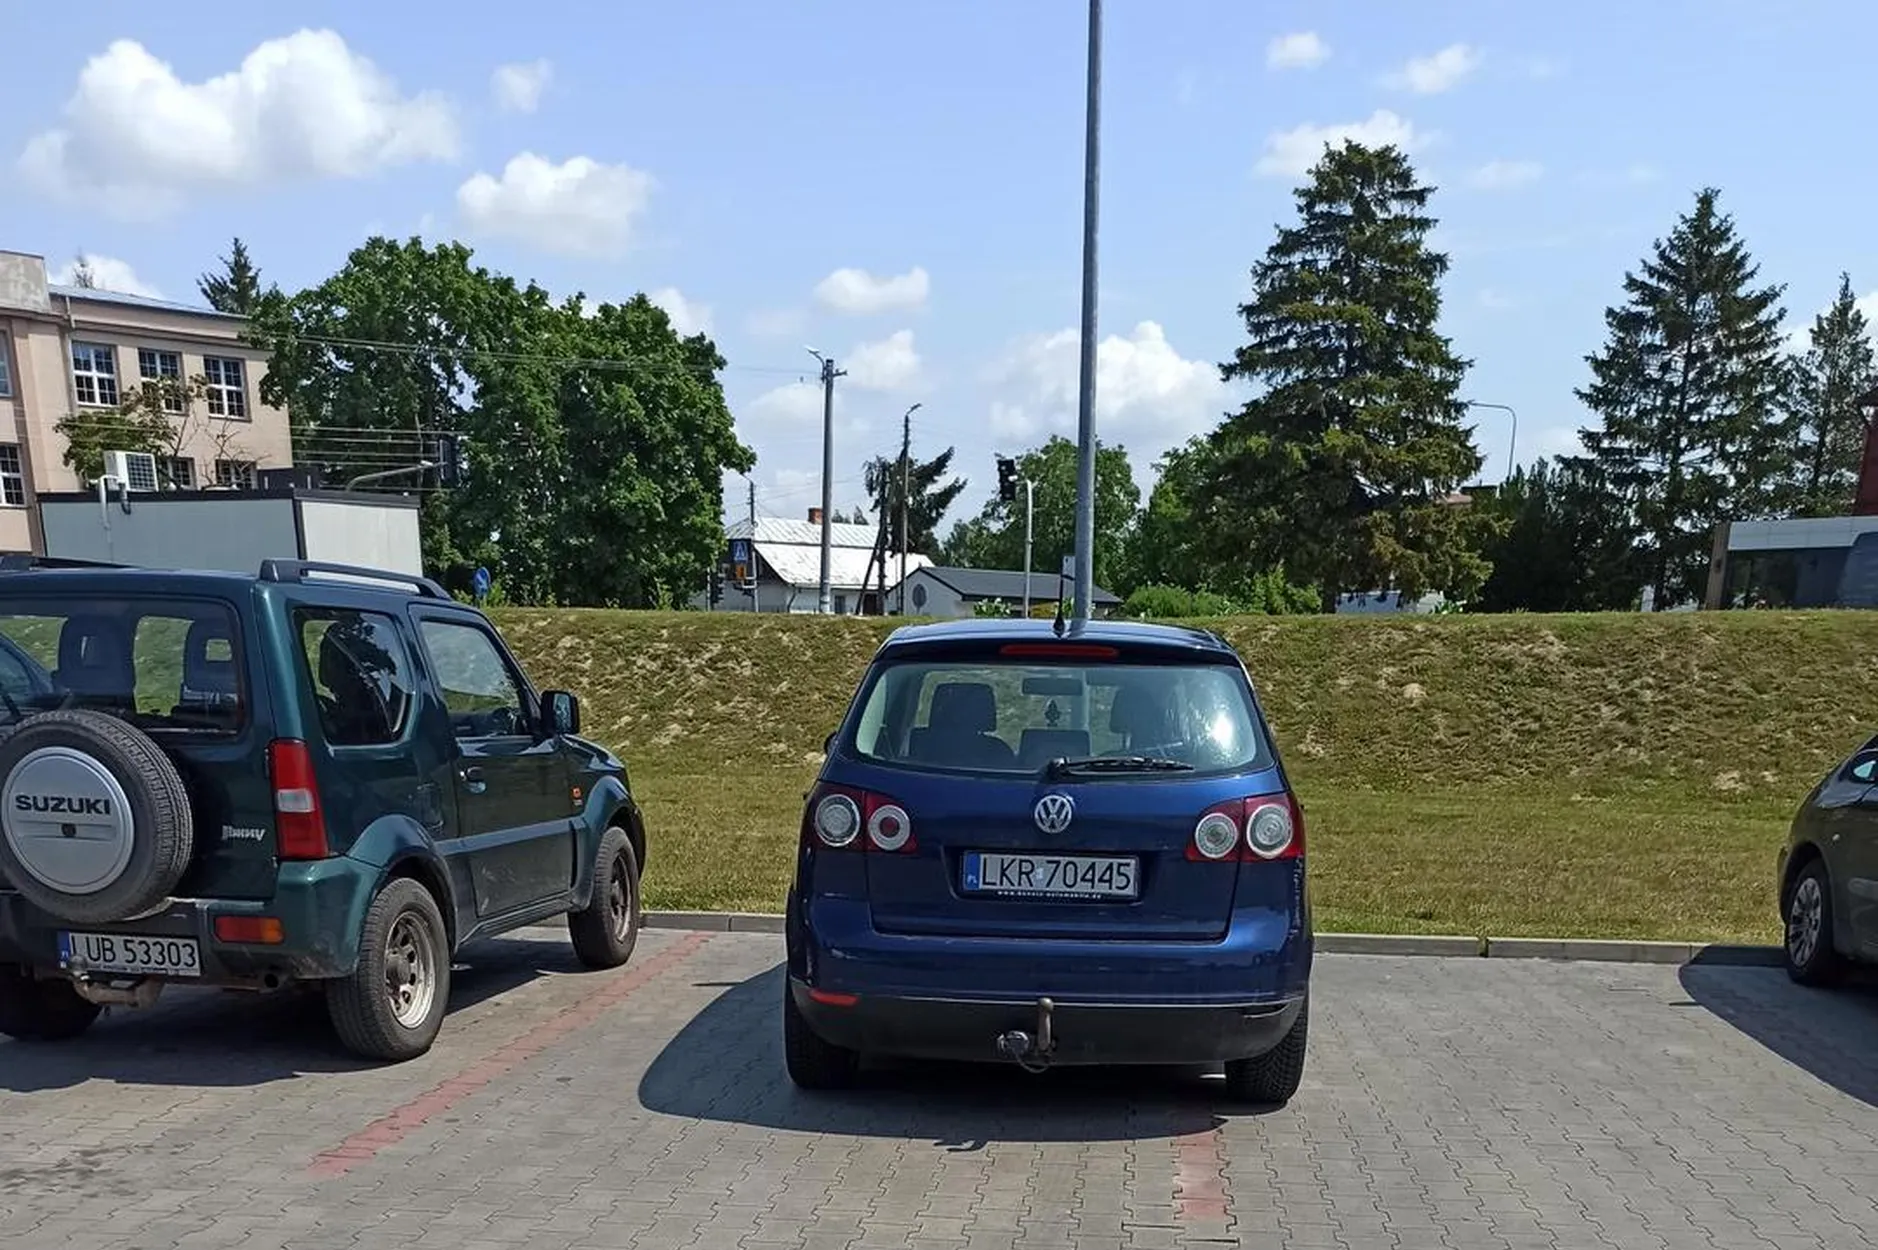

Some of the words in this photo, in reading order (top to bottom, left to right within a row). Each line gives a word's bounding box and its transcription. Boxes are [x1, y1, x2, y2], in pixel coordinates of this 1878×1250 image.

[15, 794, 111, 815] SUZUKI
[982, 857, 1035, 888] LKR
[1045, 859, 1132, 891] 70445
[123, 939, 197, 968] 53303
